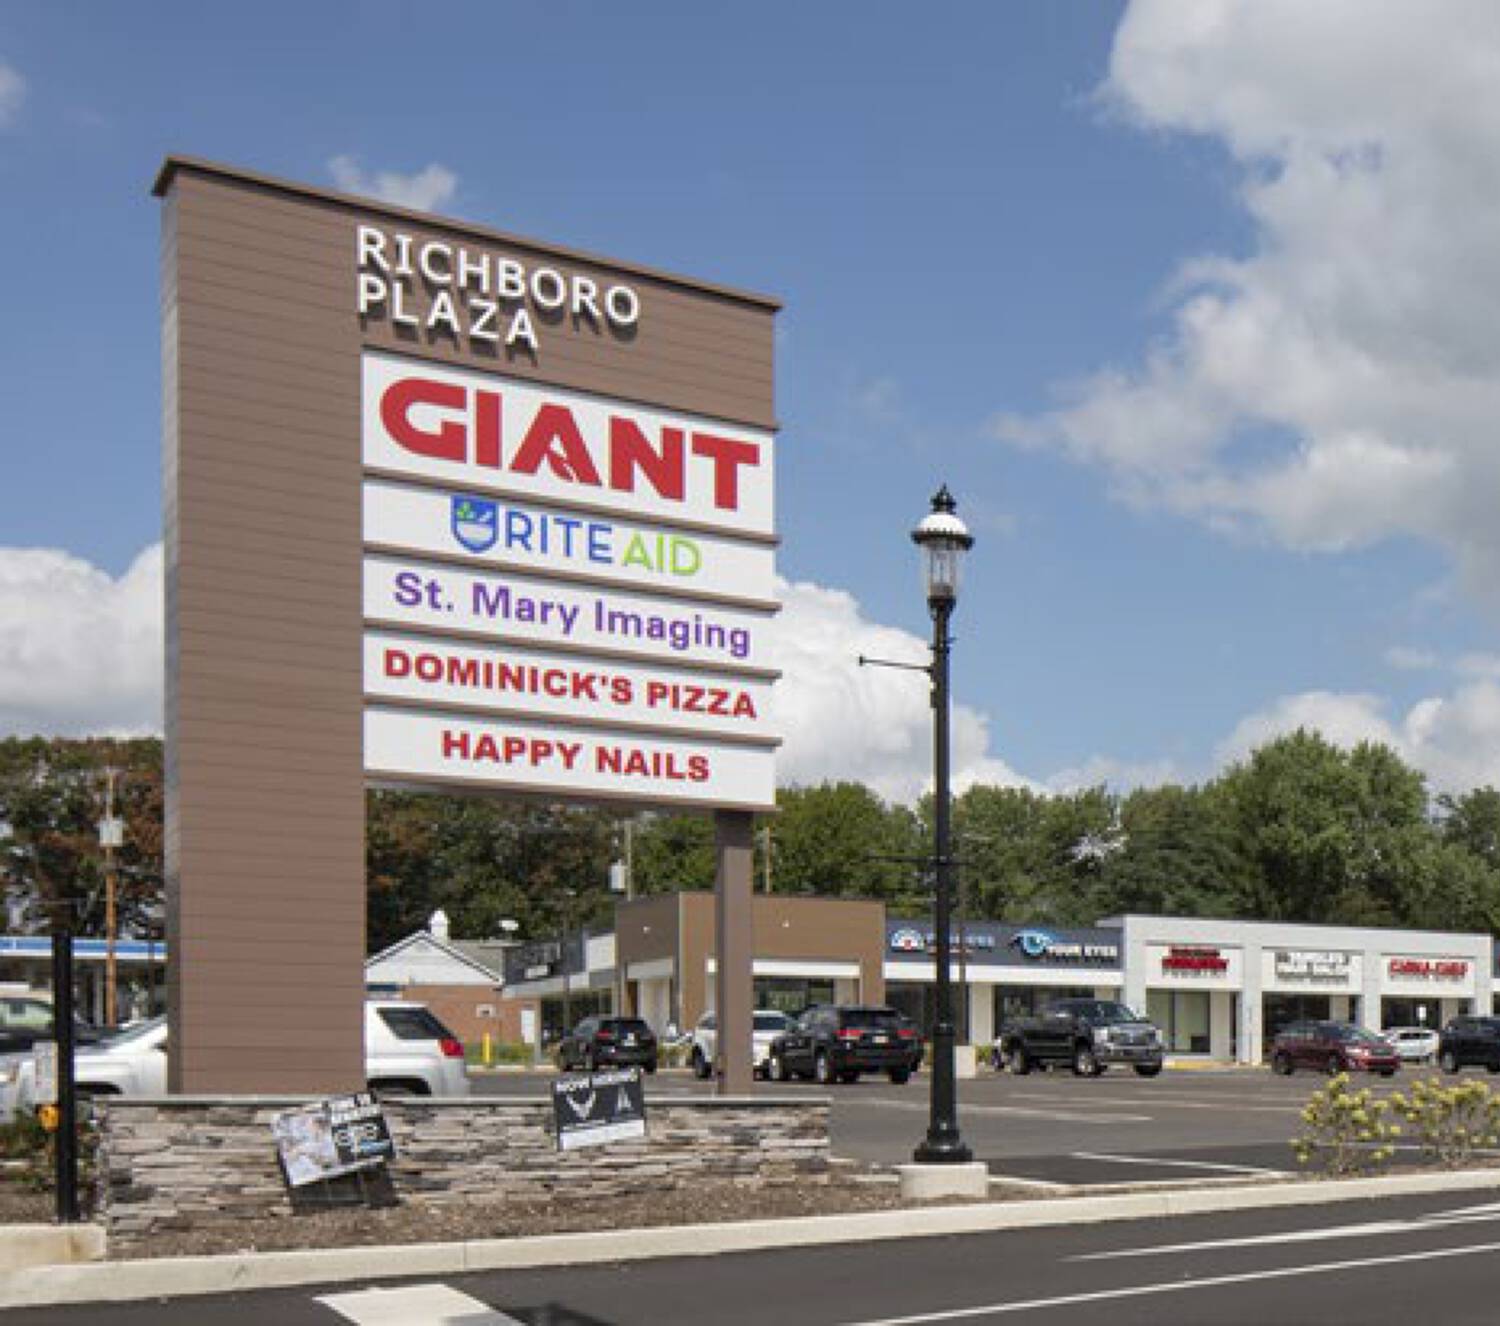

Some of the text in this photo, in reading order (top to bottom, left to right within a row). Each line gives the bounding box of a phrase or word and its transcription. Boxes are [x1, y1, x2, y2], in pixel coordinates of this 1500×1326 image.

[357, 226, 640, 324] RICHBORO
[358, 273, 539, 349] PLAZA
[380, 377, 761, 511] GIANT
[504, 509, 702, 576] RITE AID
[394, 572, 751, 658] St. Mary Imaging
[383, 649, 758, 720] DOMINICK'S PIZZA
[442, 730, 711, 782] HAPPY NAILS
